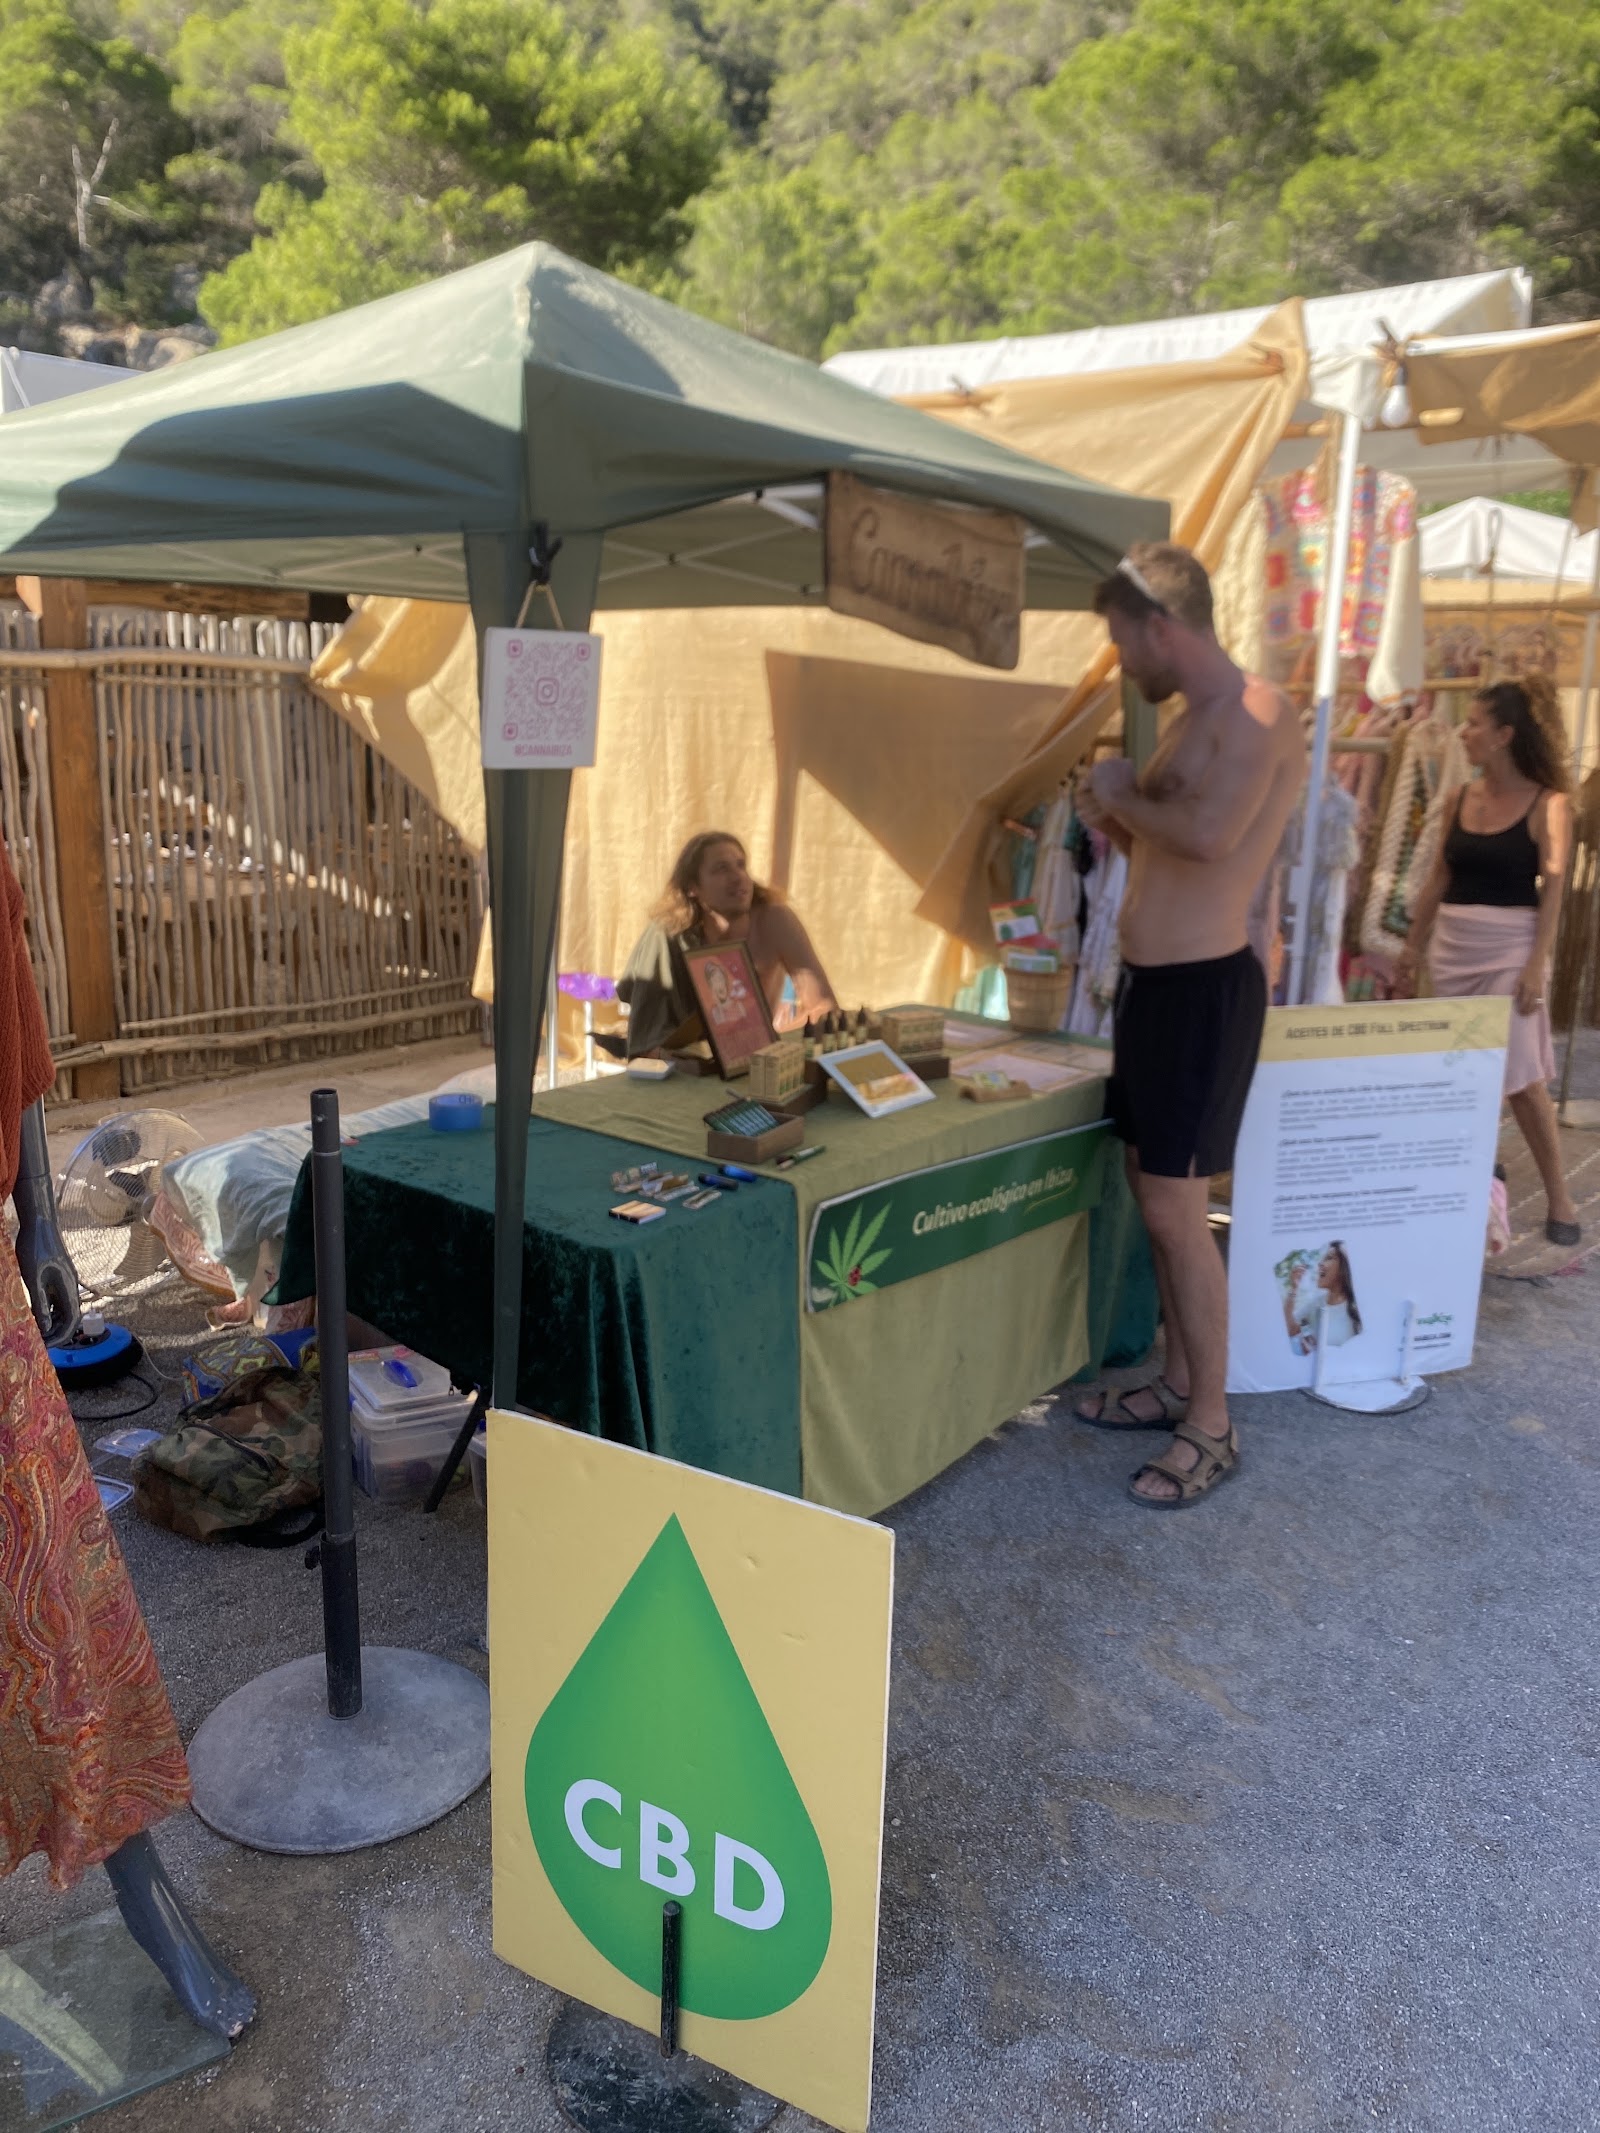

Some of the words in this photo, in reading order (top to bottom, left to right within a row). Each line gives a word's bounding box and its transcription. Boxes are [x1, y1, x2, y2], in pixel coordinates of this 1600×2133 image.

[912, 1202, 968, 1236] Cultivo
[968, 1182, 1028, 1217] ecológico
[1027, 1178, 1043, 1196] en
[1044, 1165, 1074, 1189] Ibiza
[564, 1778, 785, 1931] CBD
